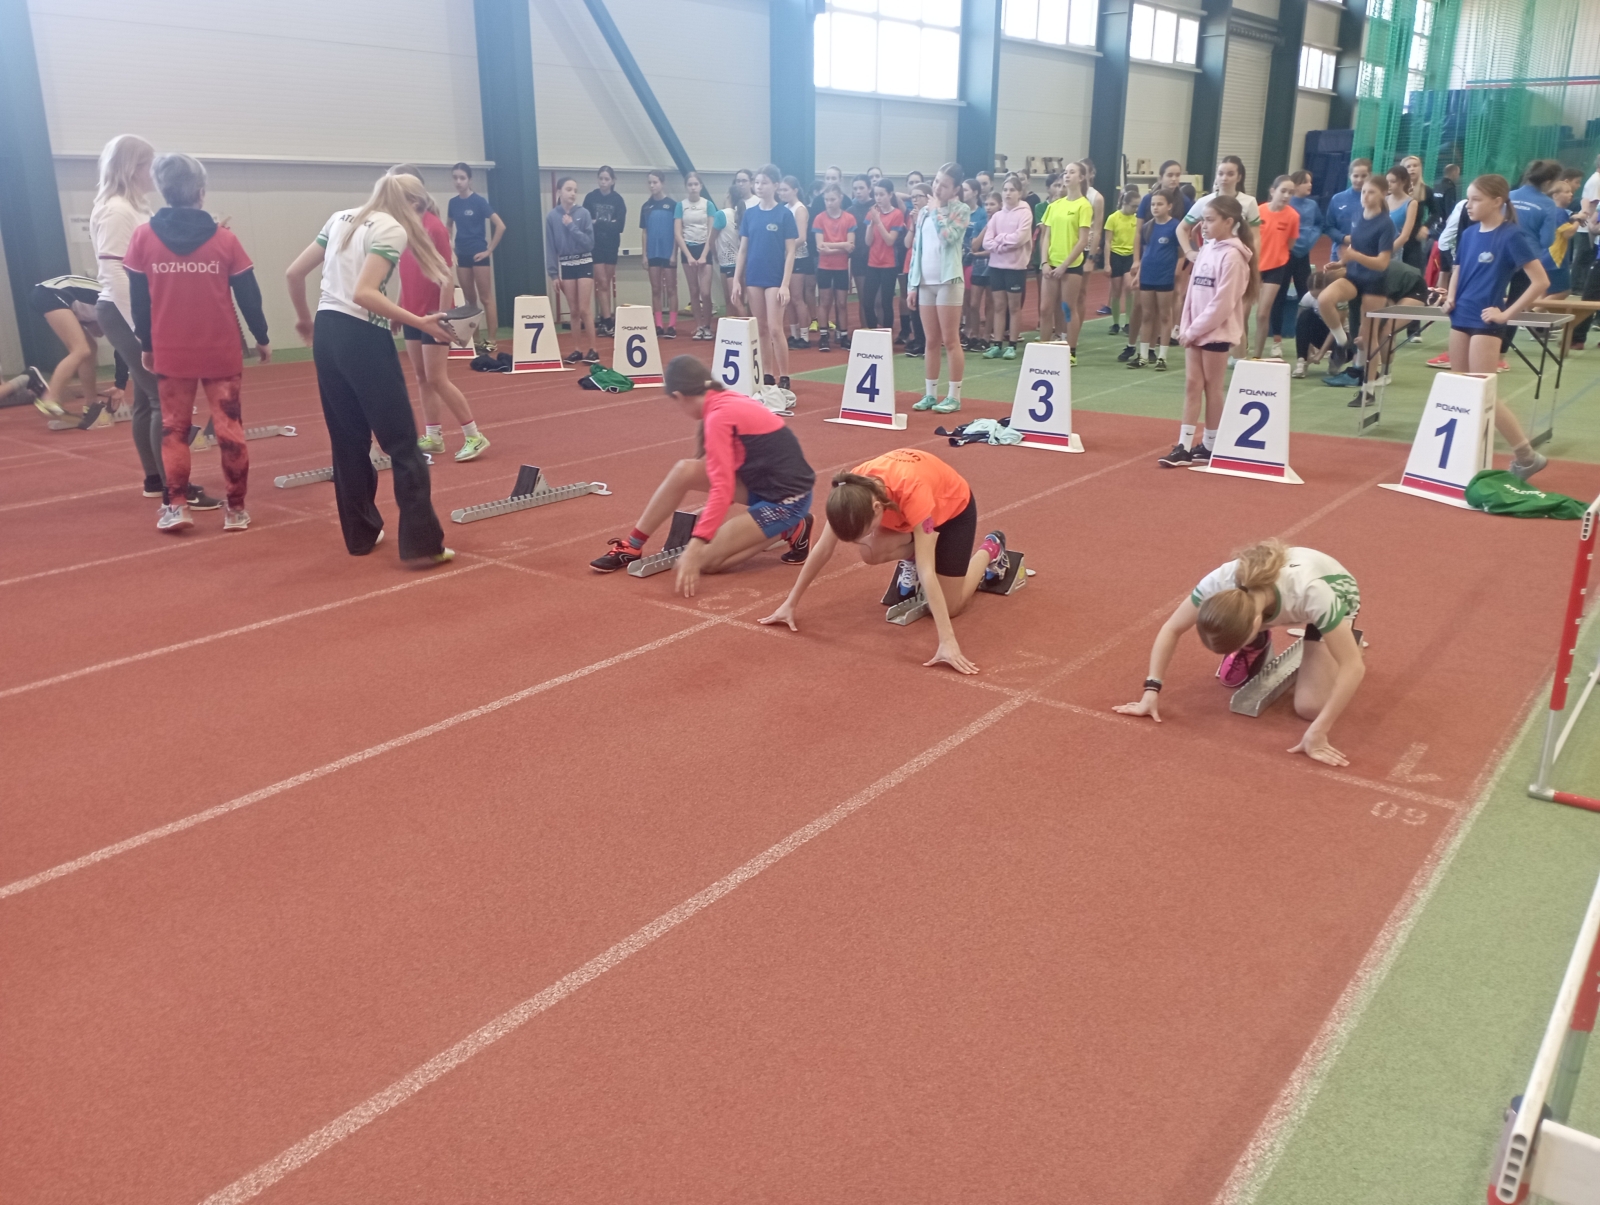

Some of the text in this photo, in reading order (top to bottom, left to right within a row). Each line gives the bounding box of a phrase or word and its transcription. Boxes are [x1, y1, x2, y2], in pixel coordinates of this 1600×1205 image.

[151, 260, 220, 275] ROZHODČÍ
[524, 322, 544, 354] 7
[626, 334, 648, 368] 6
[720, 338, 743, 347] POLANIK
[721, 348, 740, 386] 5
[752, 347, 760, 385] 5
[856, 352, 884, 361] POLANIK
[1029, 367, 1061, 377] POLANIK
[856, 363, 880, 403] 4
[1239, 387, 1278, 398] POLANIK
[1028, 379, 1054, 423] 3
[1435, 402, 1471, 415] POLANIK
[1234, 401, 1270, 450] 2
[1434, 417, 1458, 470] 1
